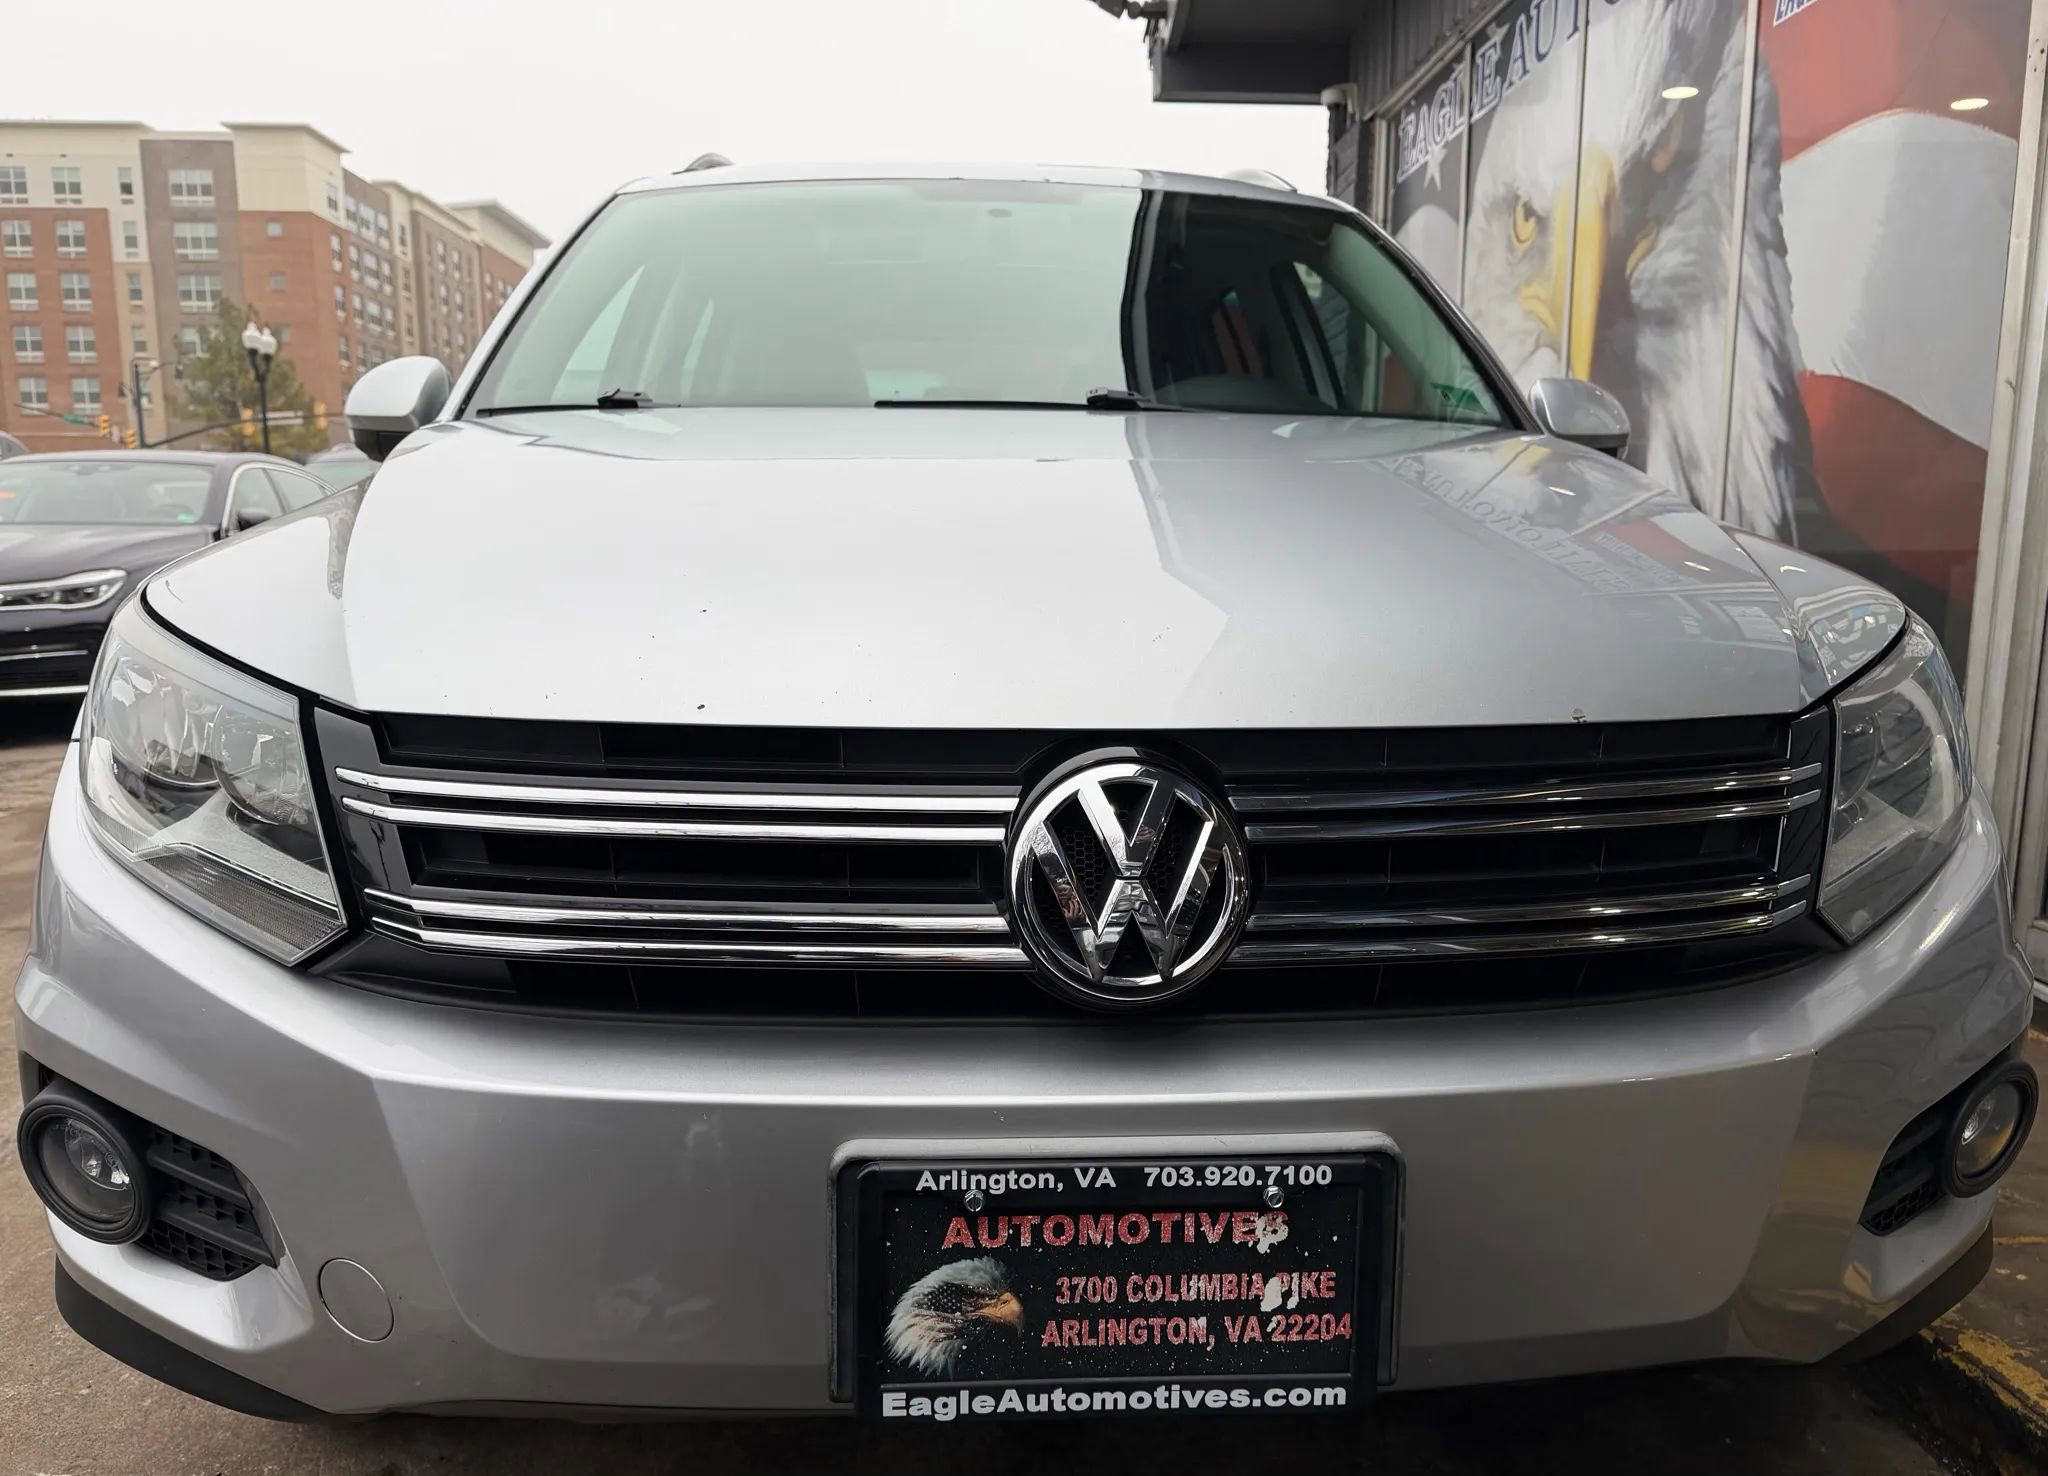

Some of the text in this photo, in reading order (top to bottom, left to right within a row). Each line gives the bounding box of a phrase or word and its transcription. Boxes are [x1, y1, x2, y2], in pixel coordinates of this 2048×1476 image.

[915, 1165, 1333, 1195] Arlington, VA 703.920.7100
[941, 1210, 1289, 1249] AUTOMOTIVES
[1055, 1275, 1118, 1304] 3700
[1126, 1271, 1265, 1302] COLUMBIA
[1041, 1312, 1353, 1351] ARLINGTON, VA 22204
[882, 1385, 1347, 1422] EagleAutomotives.com
